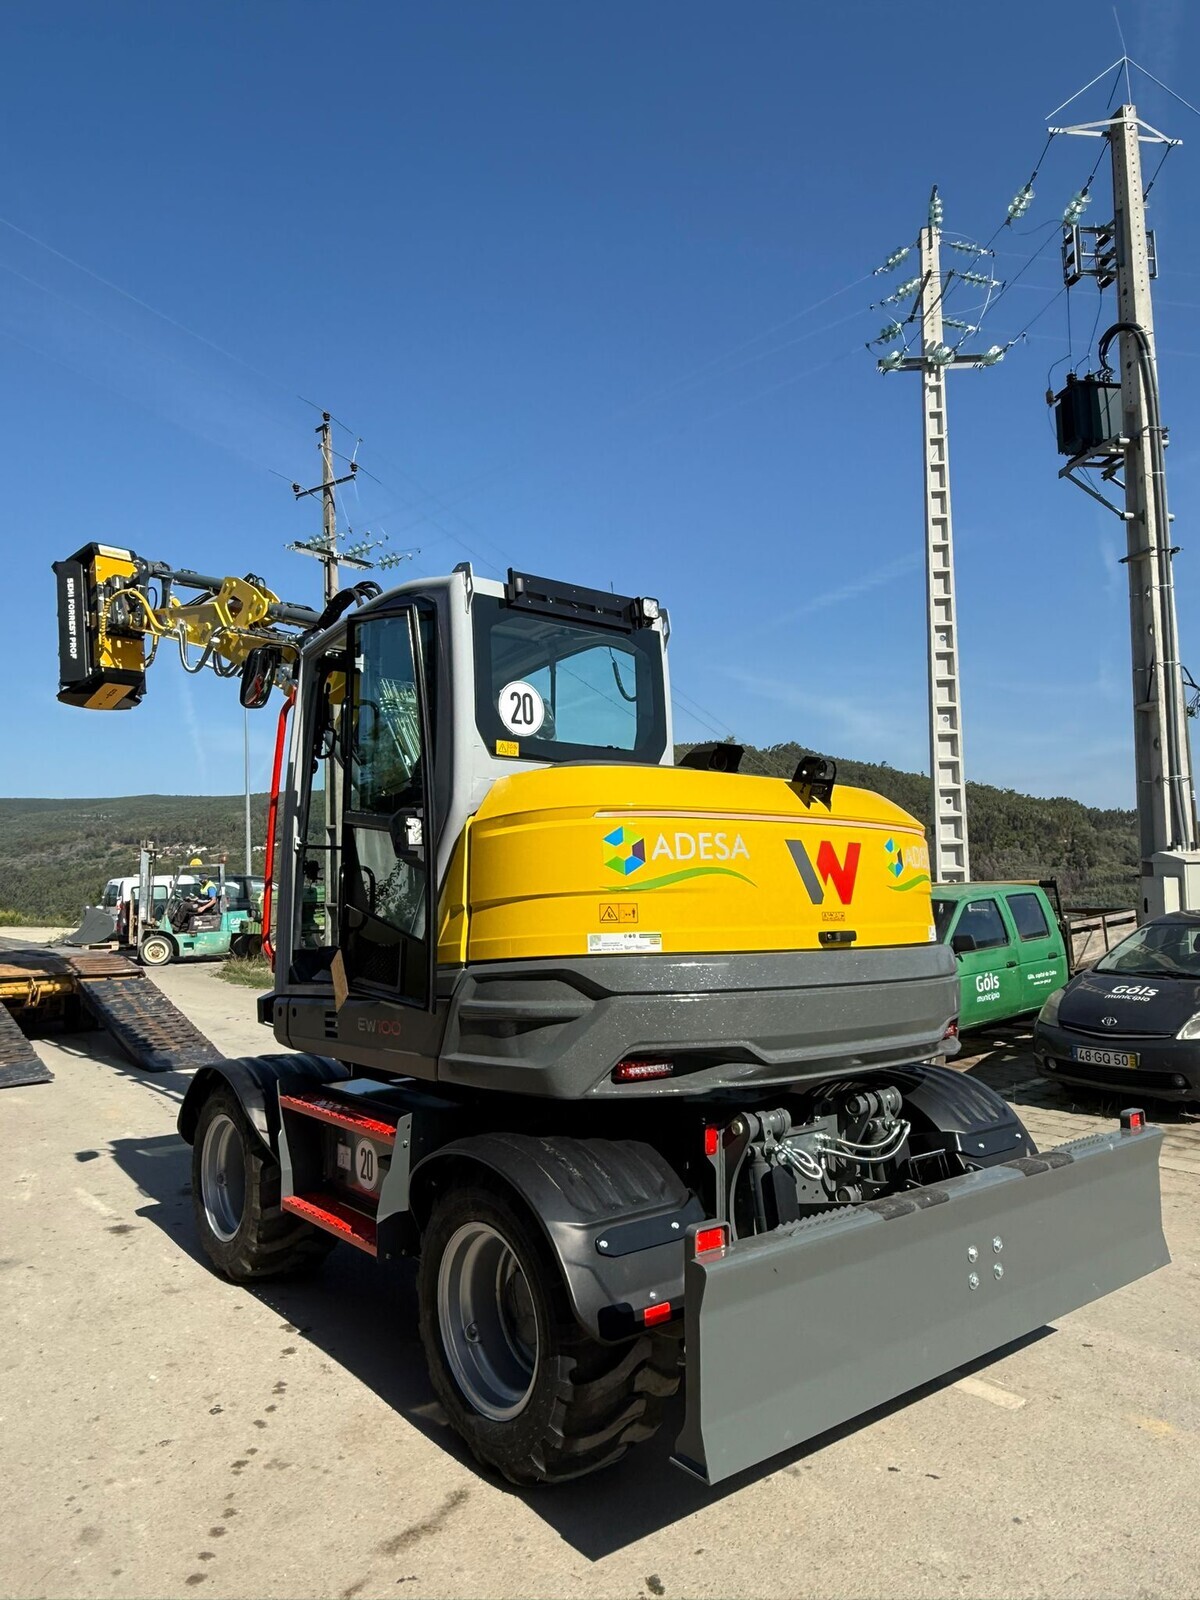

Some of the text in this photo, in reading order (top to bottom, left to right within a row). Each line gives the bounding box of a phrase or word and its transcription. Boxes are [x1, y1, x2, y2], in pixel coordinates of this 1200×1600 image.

[67, 577, 78, 660] SEMI FORREST PROF
[510, 691, 534, 725] 20
[651, 833, 751, 861] ADESA
[357, 1017, 402, 1036] EW100
[360, 1147, 373, 1181] 20
